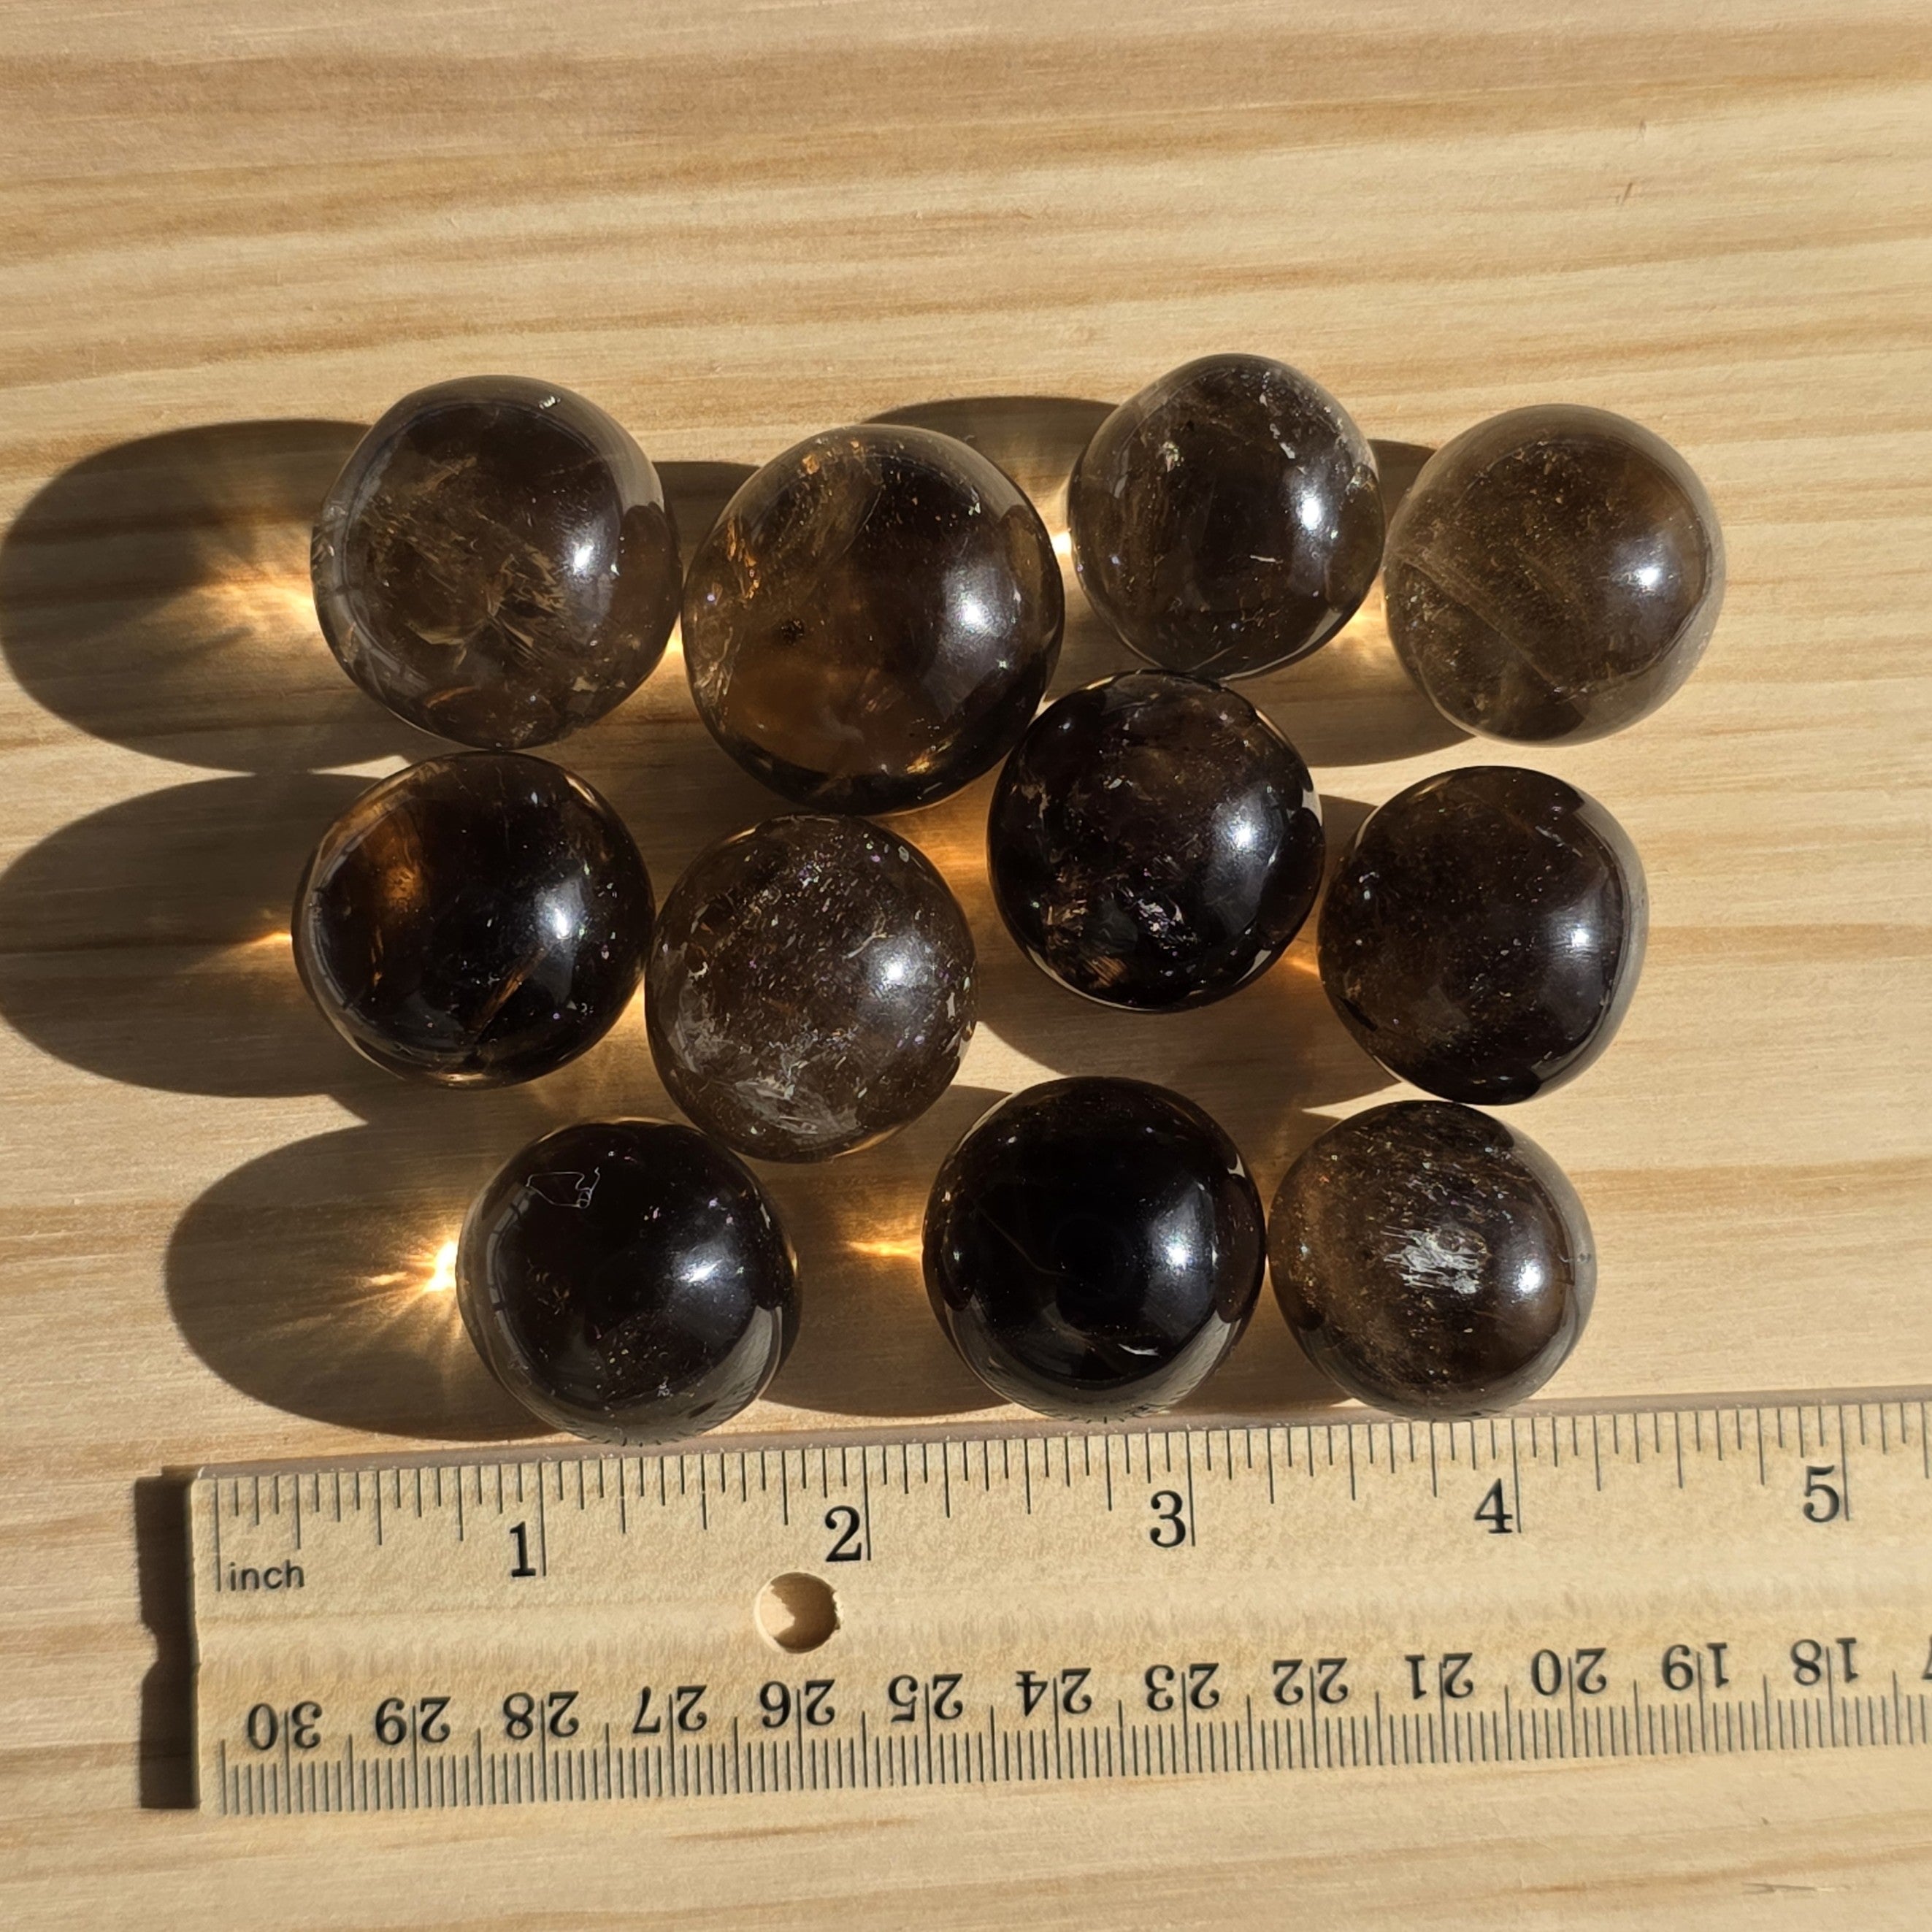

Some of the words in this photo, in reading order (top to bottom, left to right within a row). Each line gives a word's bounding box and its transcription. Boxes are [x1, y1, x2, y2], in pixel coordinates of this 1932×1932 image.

[510, 1522, 537, 1577] 1
[825, 1506, 862, 1563] 2
[1149, 1490, 1187, 1548] 3
[1473, 1478, 1513, 1534] 4
[1803, 1465, 1841, 1523] 5
[228, 1559, 305, 1592] inch
[1273, 1657, 1349, 1705] 22
[1404, 1652, 1474, 1700] 21
[1530, 1647, 1607, 1695] 20
[1662, 1641, 1729, 1691] 19
[1790, 1637, 1859, 1686] 18
[632, 1684, 708, 1735] 27
[759, 1679, 836, 1728] 26
[888, 1673, 964, 1722] 25
[1016, 1667, 1093, 1717] 24
[1145, 1662, 1221, 1712] 23
[247, 1701, 323, 1751] 30
[375, 1696, 451, 1745] 29
[502, 1690, 580, 1739] 28
